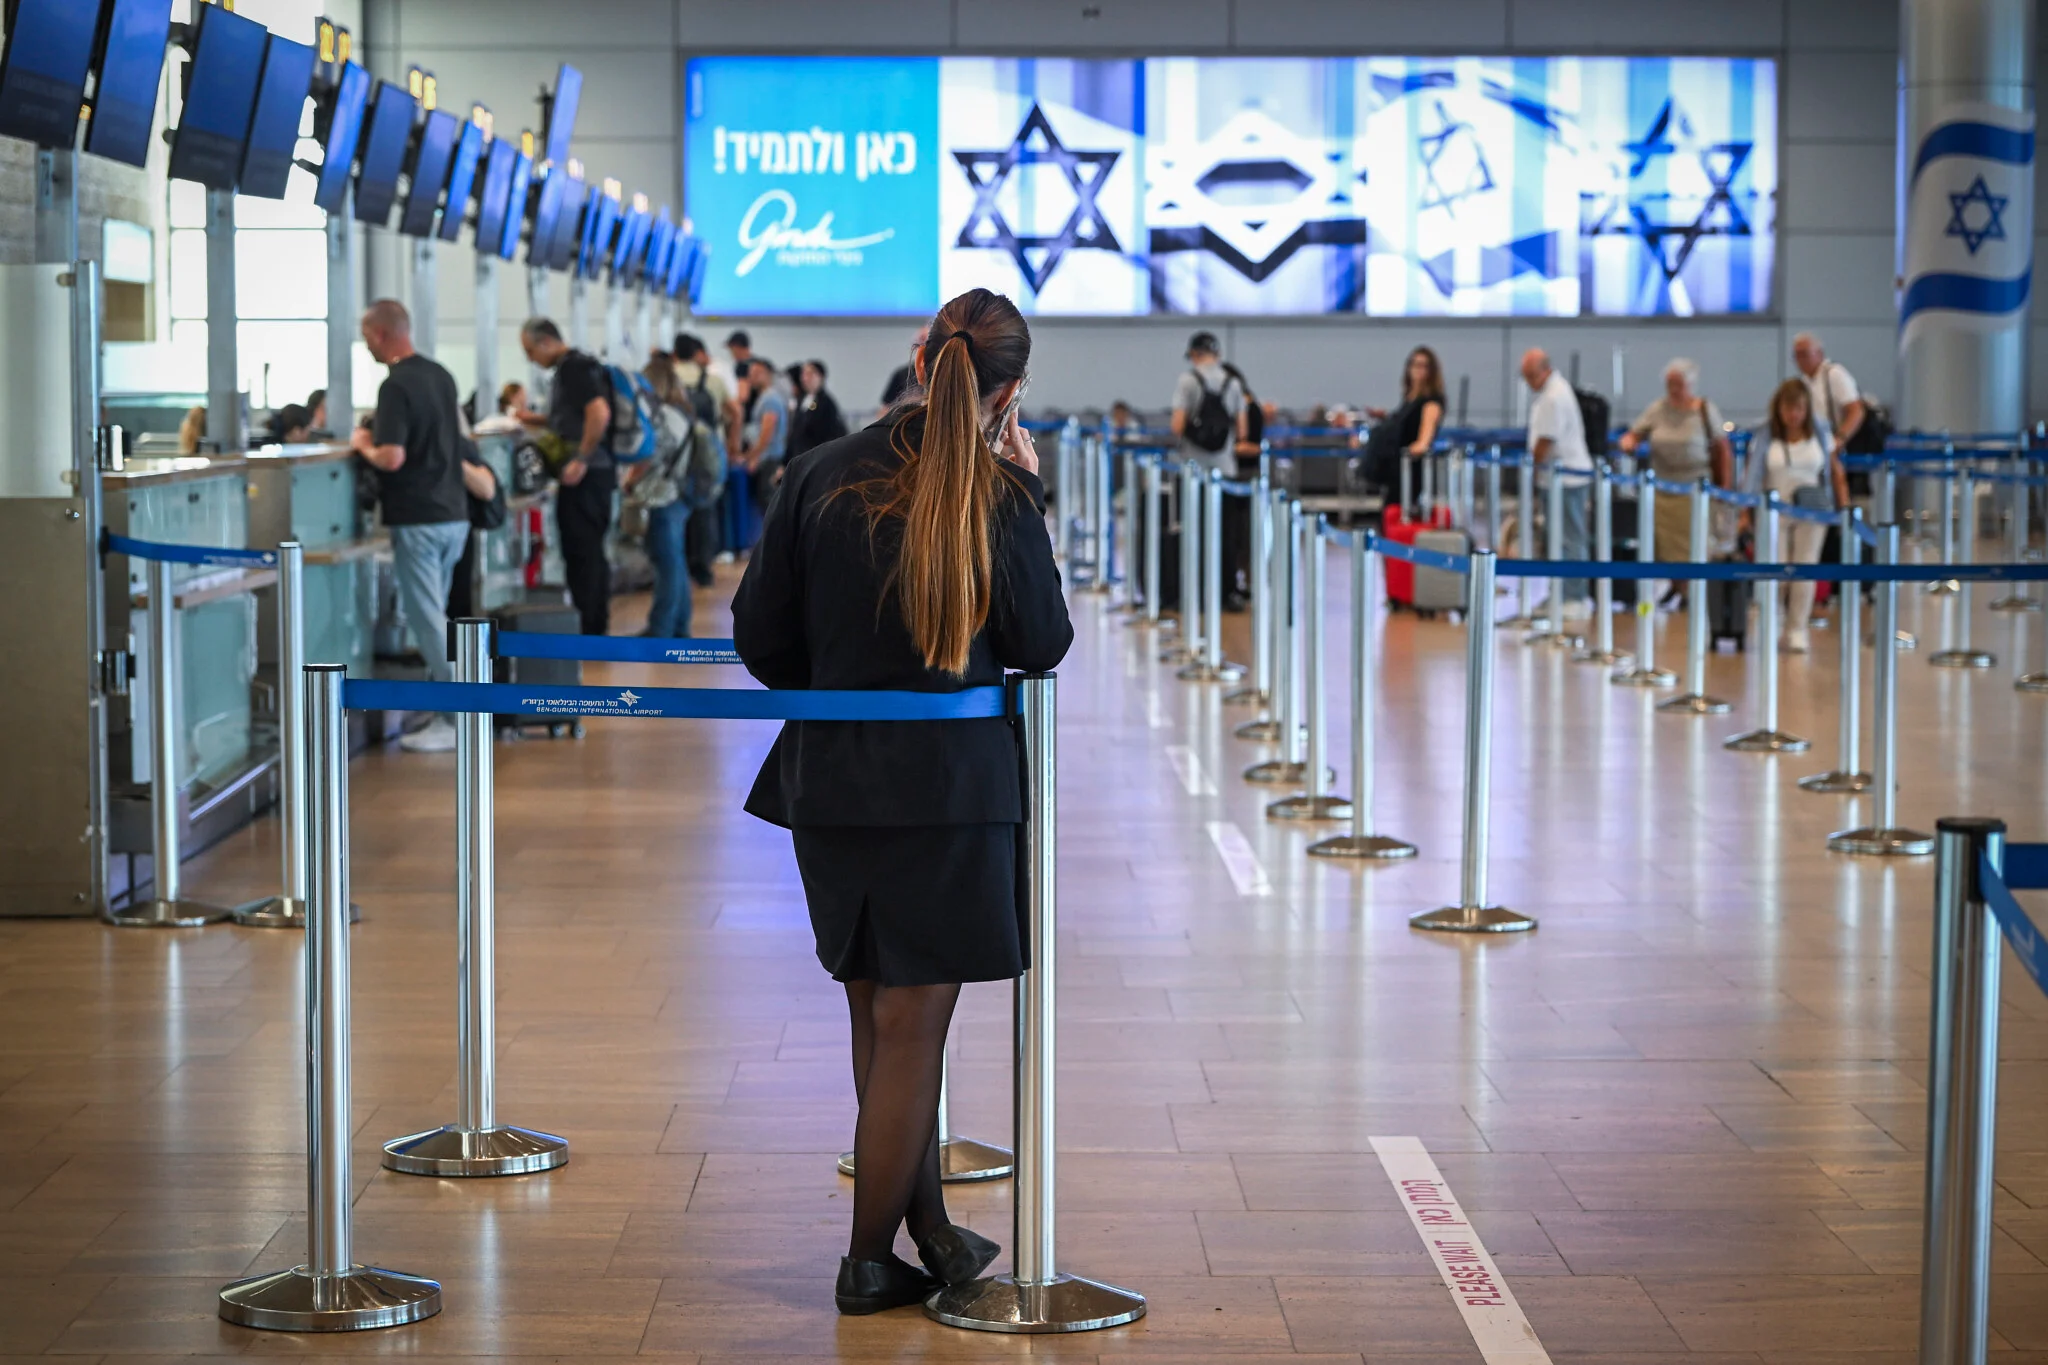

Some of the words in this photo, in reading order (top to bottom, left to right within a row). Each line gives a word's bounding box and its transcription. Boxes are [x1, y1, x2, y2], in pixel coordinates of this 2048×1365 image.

[713, 125, 846, 175] ולתמיד!
[855, 131, 917, 182] כאן
[546, 698, 577, 706] הבינלאומי
[606, 699, 618, 707] נמל
[1416, 1208, 1467, 1225] כאן
[1433, 1240, 1481, 1264] WAIT
[1448, 1265, 1506, 1306] PLEASE
